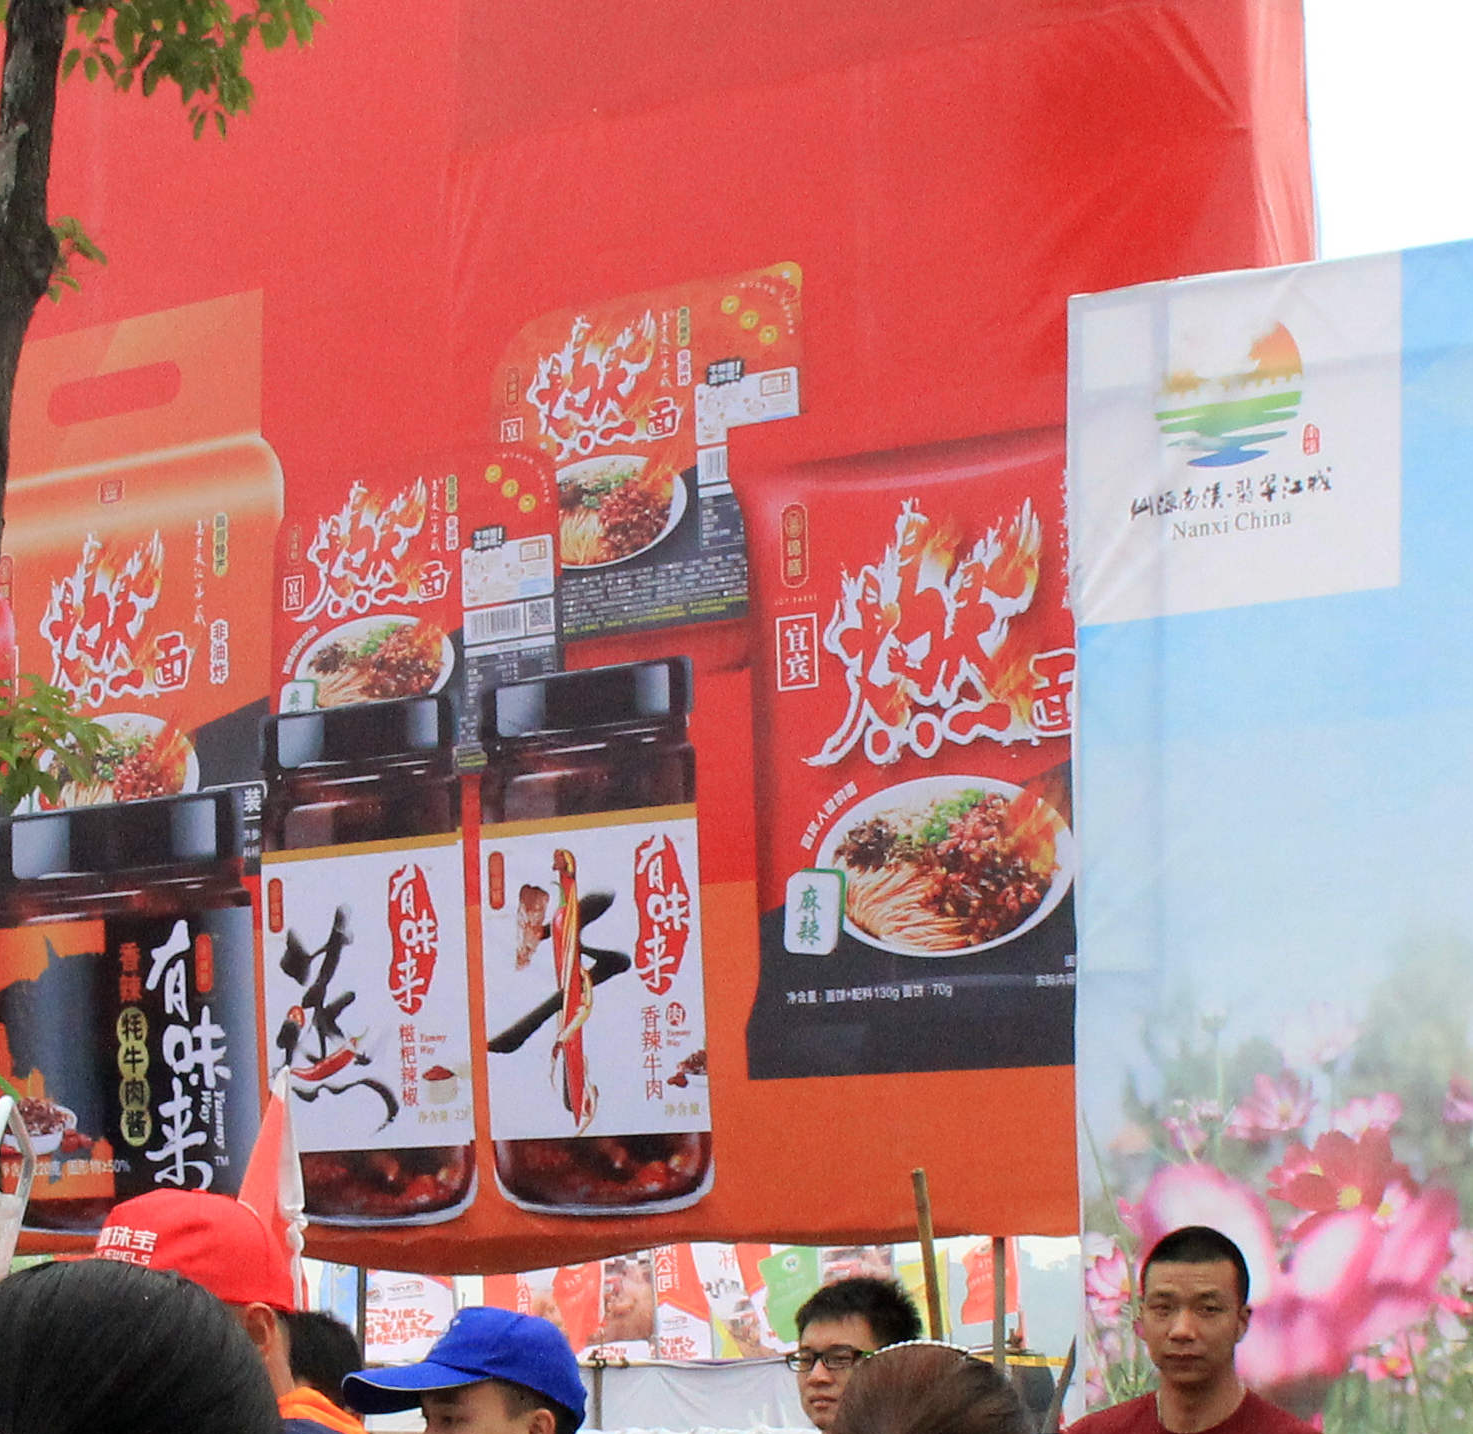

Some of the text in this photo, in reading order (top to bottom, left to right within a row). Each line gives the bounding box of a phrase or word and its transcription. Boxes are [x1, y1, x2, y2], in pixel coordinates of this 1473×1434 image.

[1172, 511, 1292, 541] Nanxi China
[785, 623, 810, 682] 宜宾
[390, 864, 437, 1008] 有味来
[636, 835, 691, 990] 有味来
[146, 920, 231, 1190] 有味来
[641, 1004, 664, 1100] 香辣牛肉
